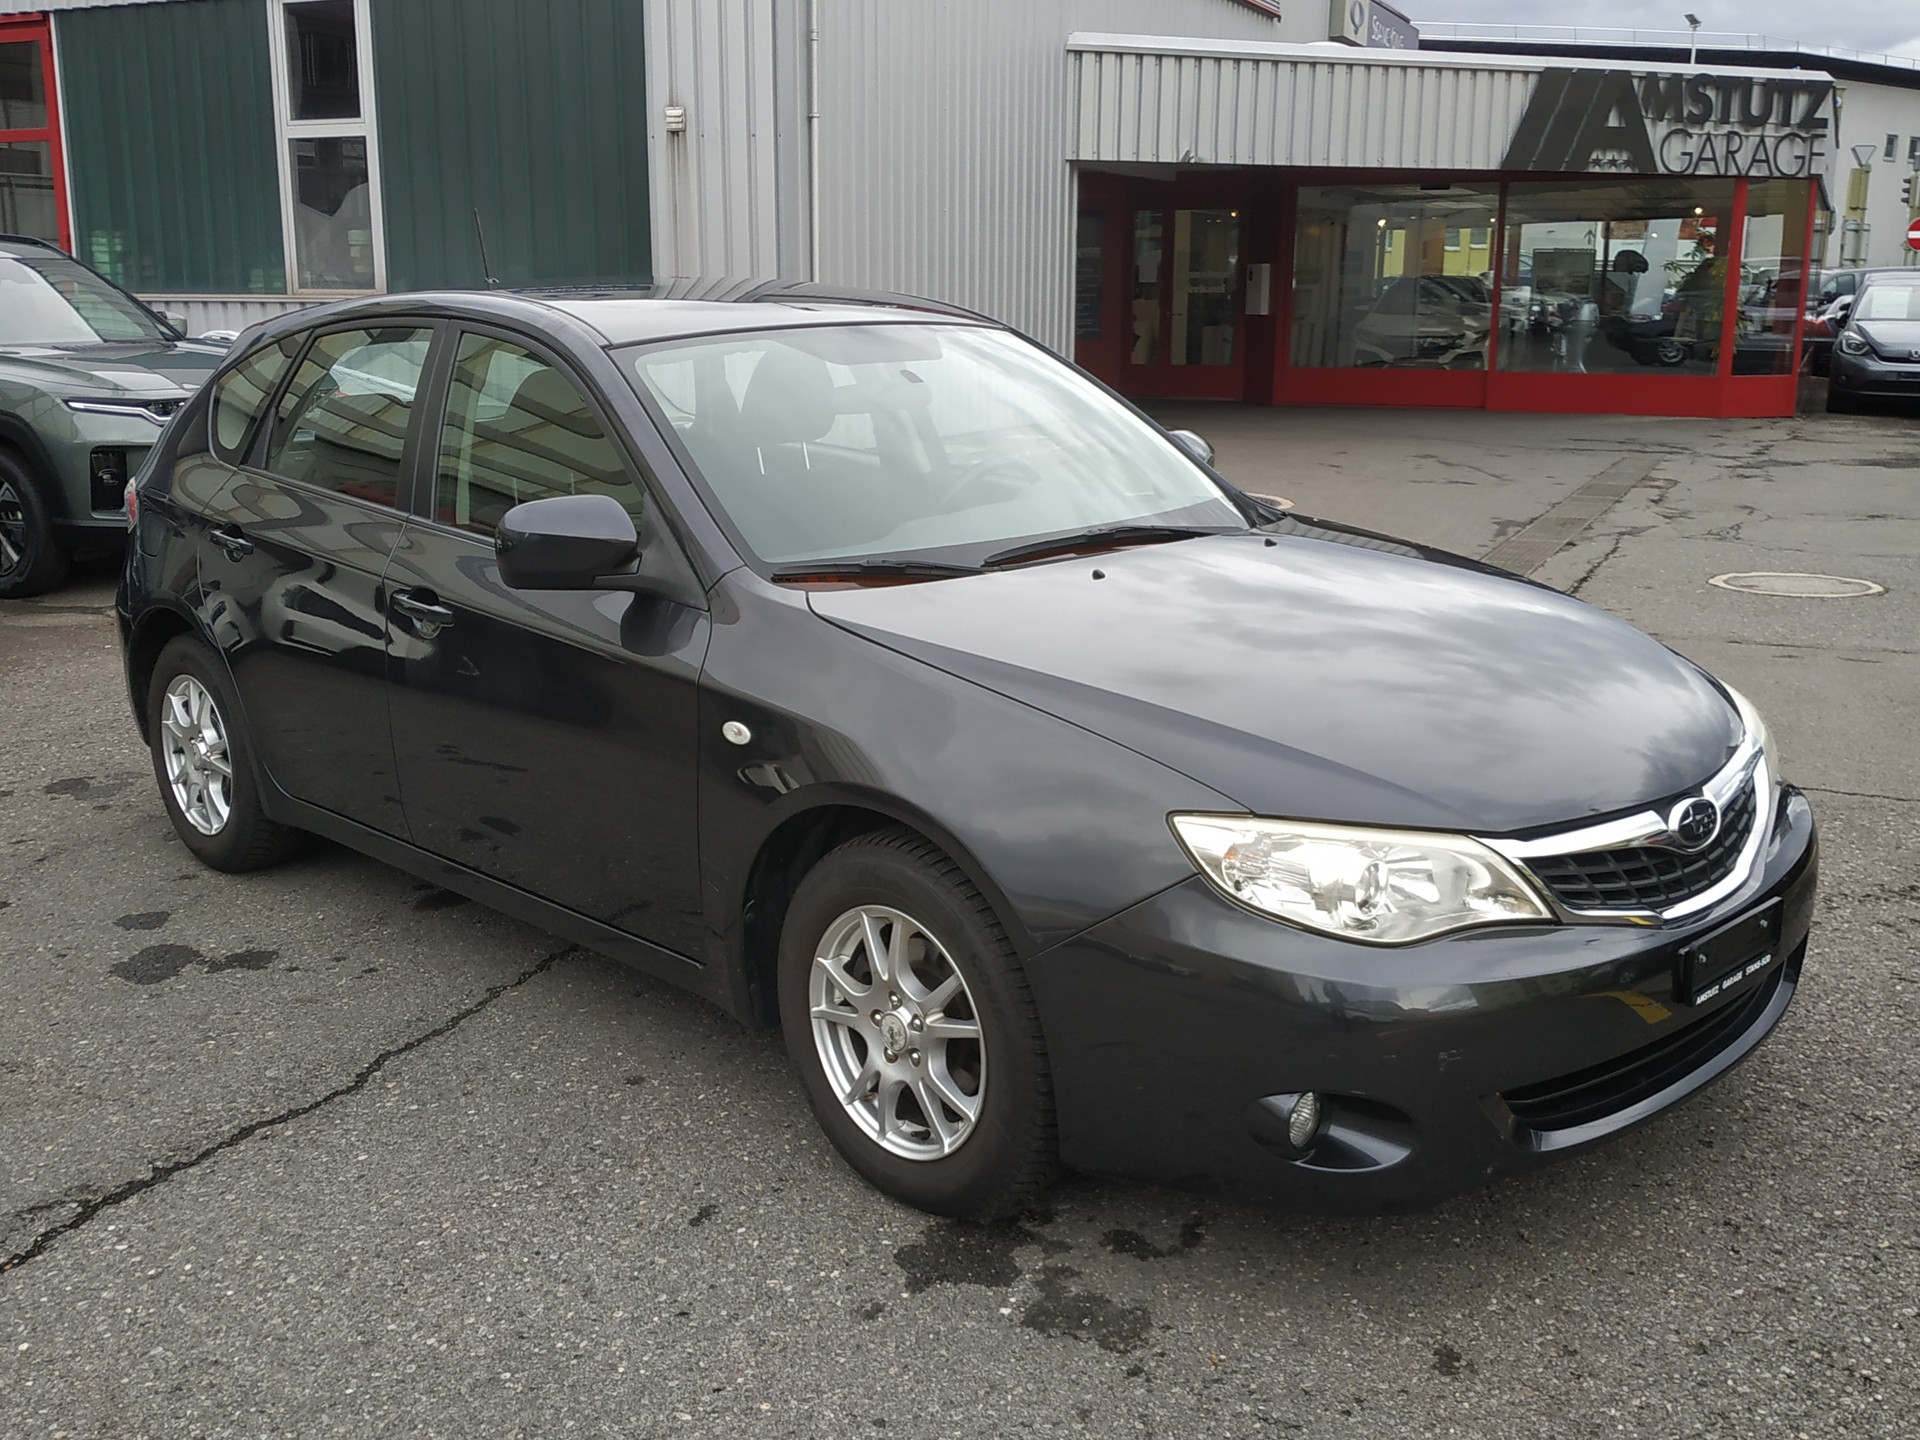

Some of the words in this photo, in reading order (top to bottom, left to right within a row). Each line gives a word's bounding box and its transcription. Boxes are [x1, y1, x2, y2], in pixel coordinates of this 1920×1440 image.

[1563, 69, 1835, 174] AMSTUTZ
[1659, 127, 1828, 177] GARAGE
[1722, 970, 1743, 989] GARAGE
